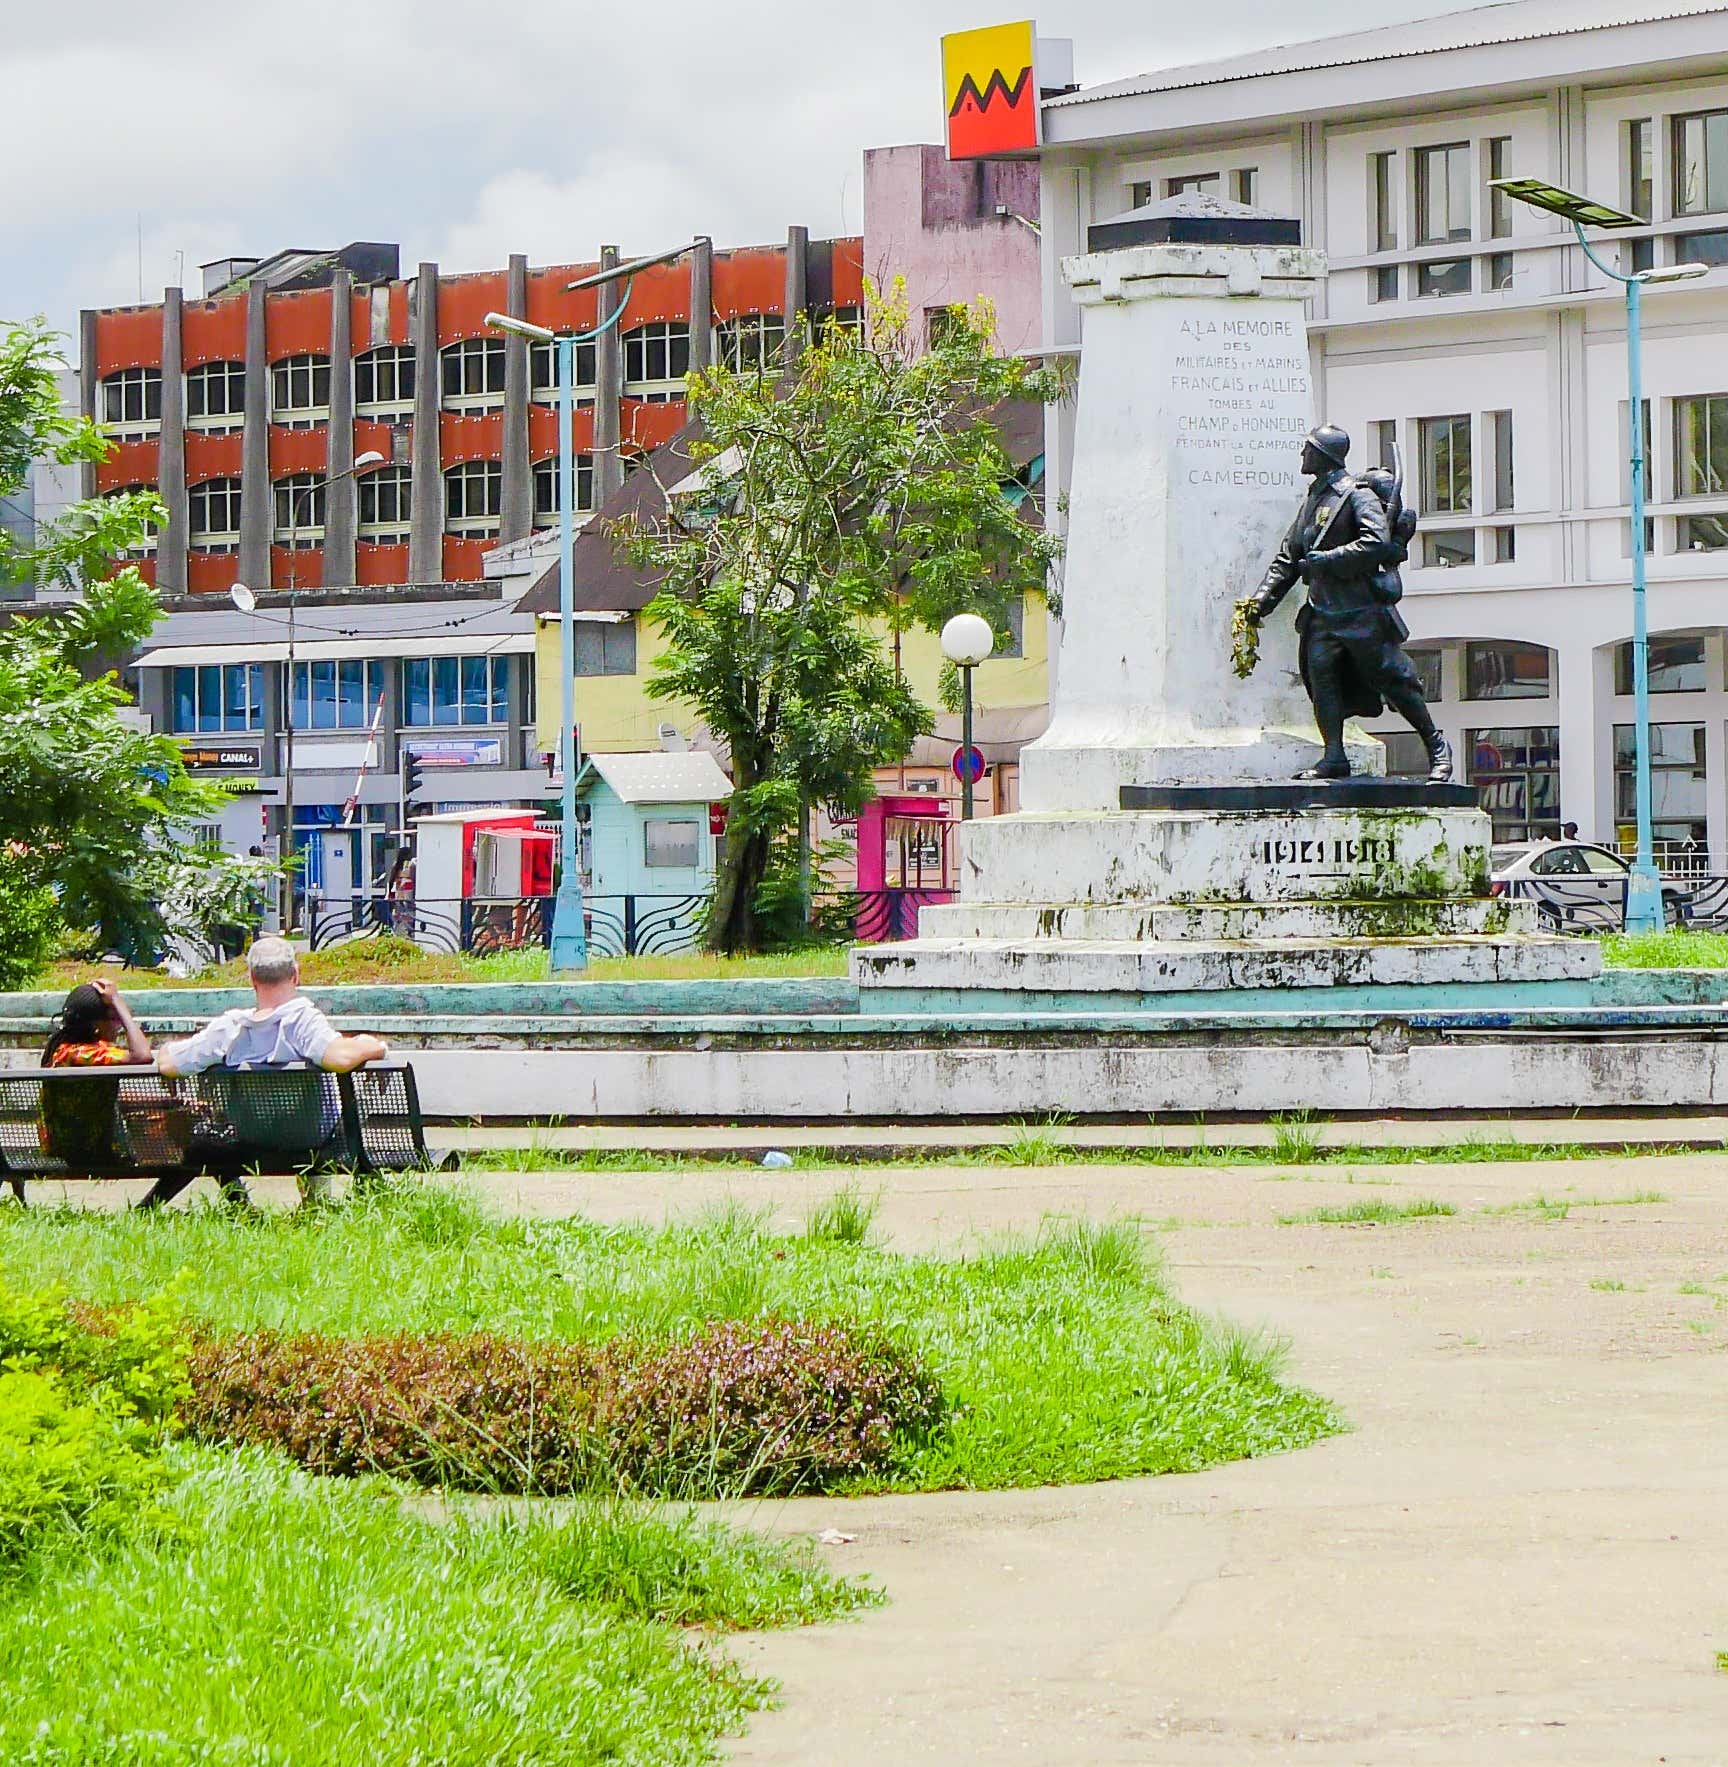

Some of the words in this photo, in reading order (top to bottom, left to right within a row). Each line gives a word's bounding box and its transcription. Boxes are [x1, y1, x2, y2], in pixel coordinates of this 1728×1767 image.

[1180, 320, 1191, 333] A
[1196, 320, 1217, 335] LA
[1223, 320, 1293, 337] MEMOIRE
[1223, 341, 1252, 352] DES
[1175, 356, 1238, 370] MILITAIRES
[1255, 357, 1303, 371] MARINS
[1262, 377, 1307, 393] ALLIES
[1208, 398, 1252, 410] TOMBES
[1259, 399, 1275, 410] AU
[1178, 415, 1230, 432] CHAMP
[1241, 417, 1306, 433] HONNEUR
[1175, 438, 1226, 449] PENDANT
[1249, 439, 1304, 450] CAMPAGN
[1234, 455, 1254, 465] DU
[1188, 469, 1294, 487] CAMEROUN
[220, 752, 254, 764] CANAL+
[1264, 840, 1324, 864] 1914
[1334, 838, 1395, 864] 1918
